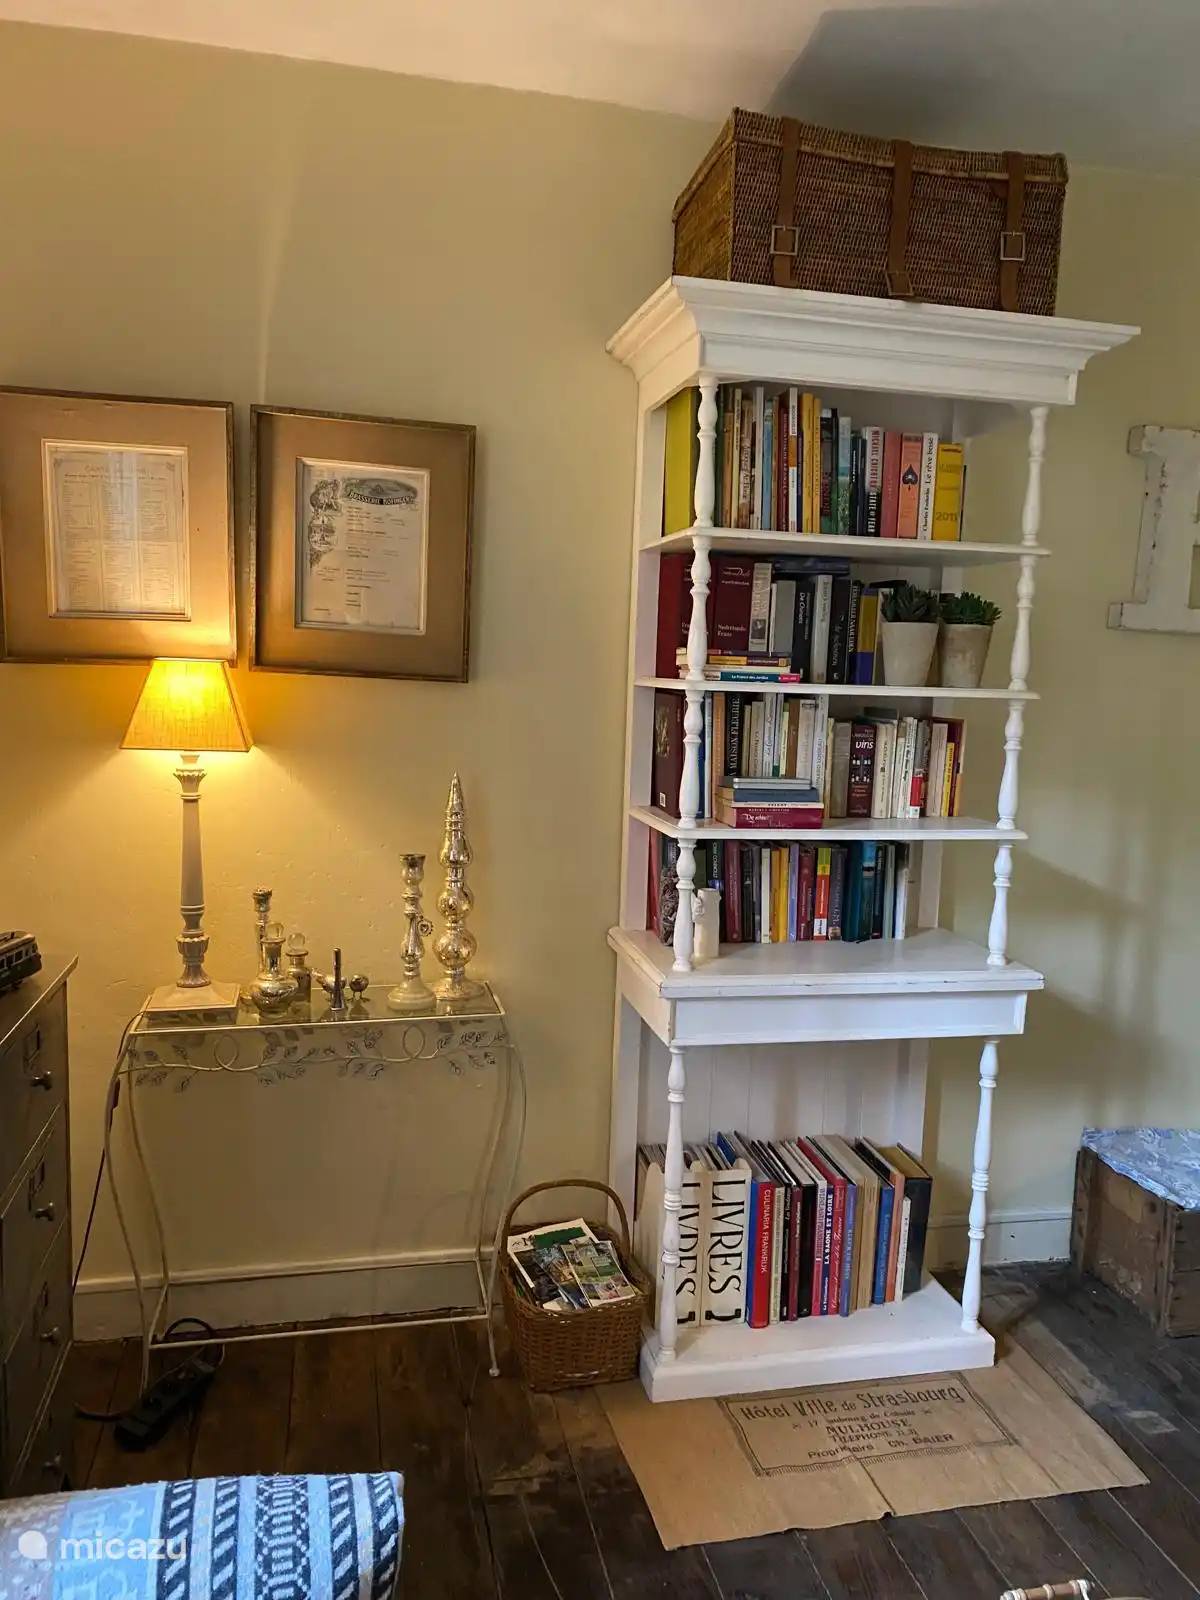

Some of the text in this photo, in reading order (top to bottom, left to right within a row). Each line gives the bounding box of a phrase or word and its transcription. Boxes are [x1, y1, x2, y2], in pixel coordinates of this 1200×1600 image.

[925, 474, 932, 484] Le
[867, 491, 877, 510] STATE
[867, 517, 876, 533] FEAR
[855, 740, 874, 749] vins
[762, 1189, 771, 1230] CULINARIA
[826, 1217, 832, 1227] ET
[708, 1179, 746, 1295] LIVRES
[824, 1254, 830, 1265] LA
[740, 1385, 965, 1421] Hôtel Ville de Strasbourg
